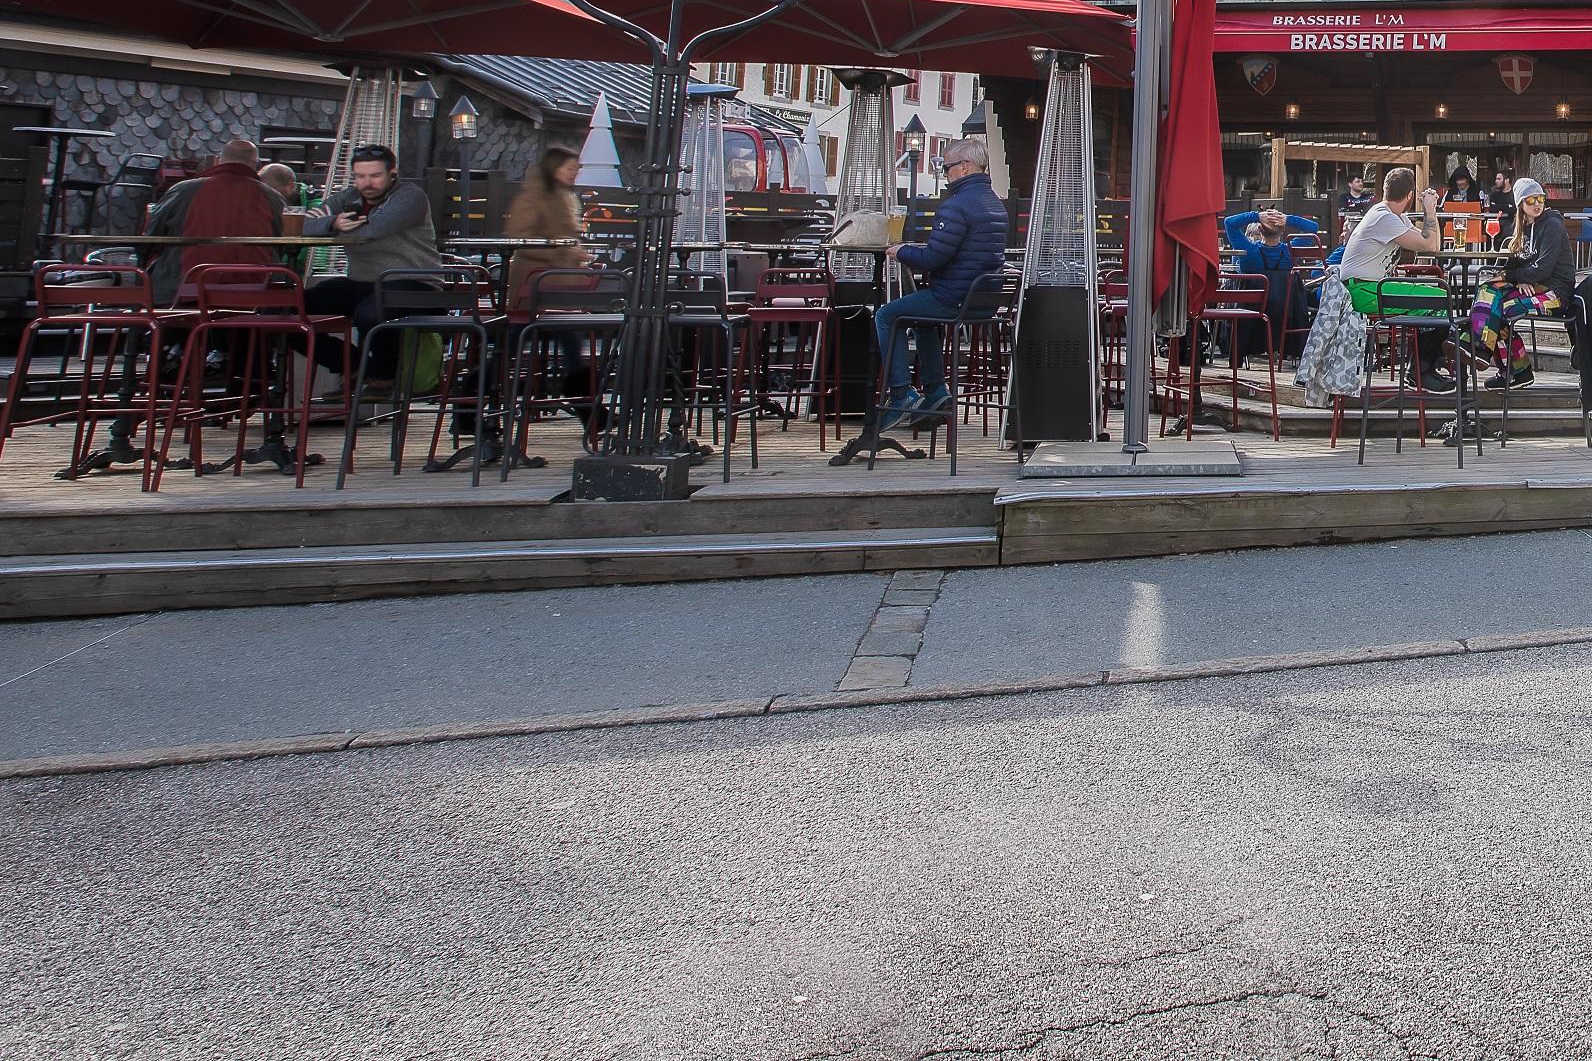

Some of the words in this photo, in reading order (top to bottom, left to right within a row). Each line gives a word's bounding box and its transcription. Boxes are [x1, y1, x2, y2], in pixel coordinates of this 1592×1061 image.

[1272, 15, 1361, 26] BRASSERIE
[1375, 13, 1405, 26] L'M
[1290, 34, 1404, 50] BRASSERIE
[1412, 33, 1447, 50] L'M
